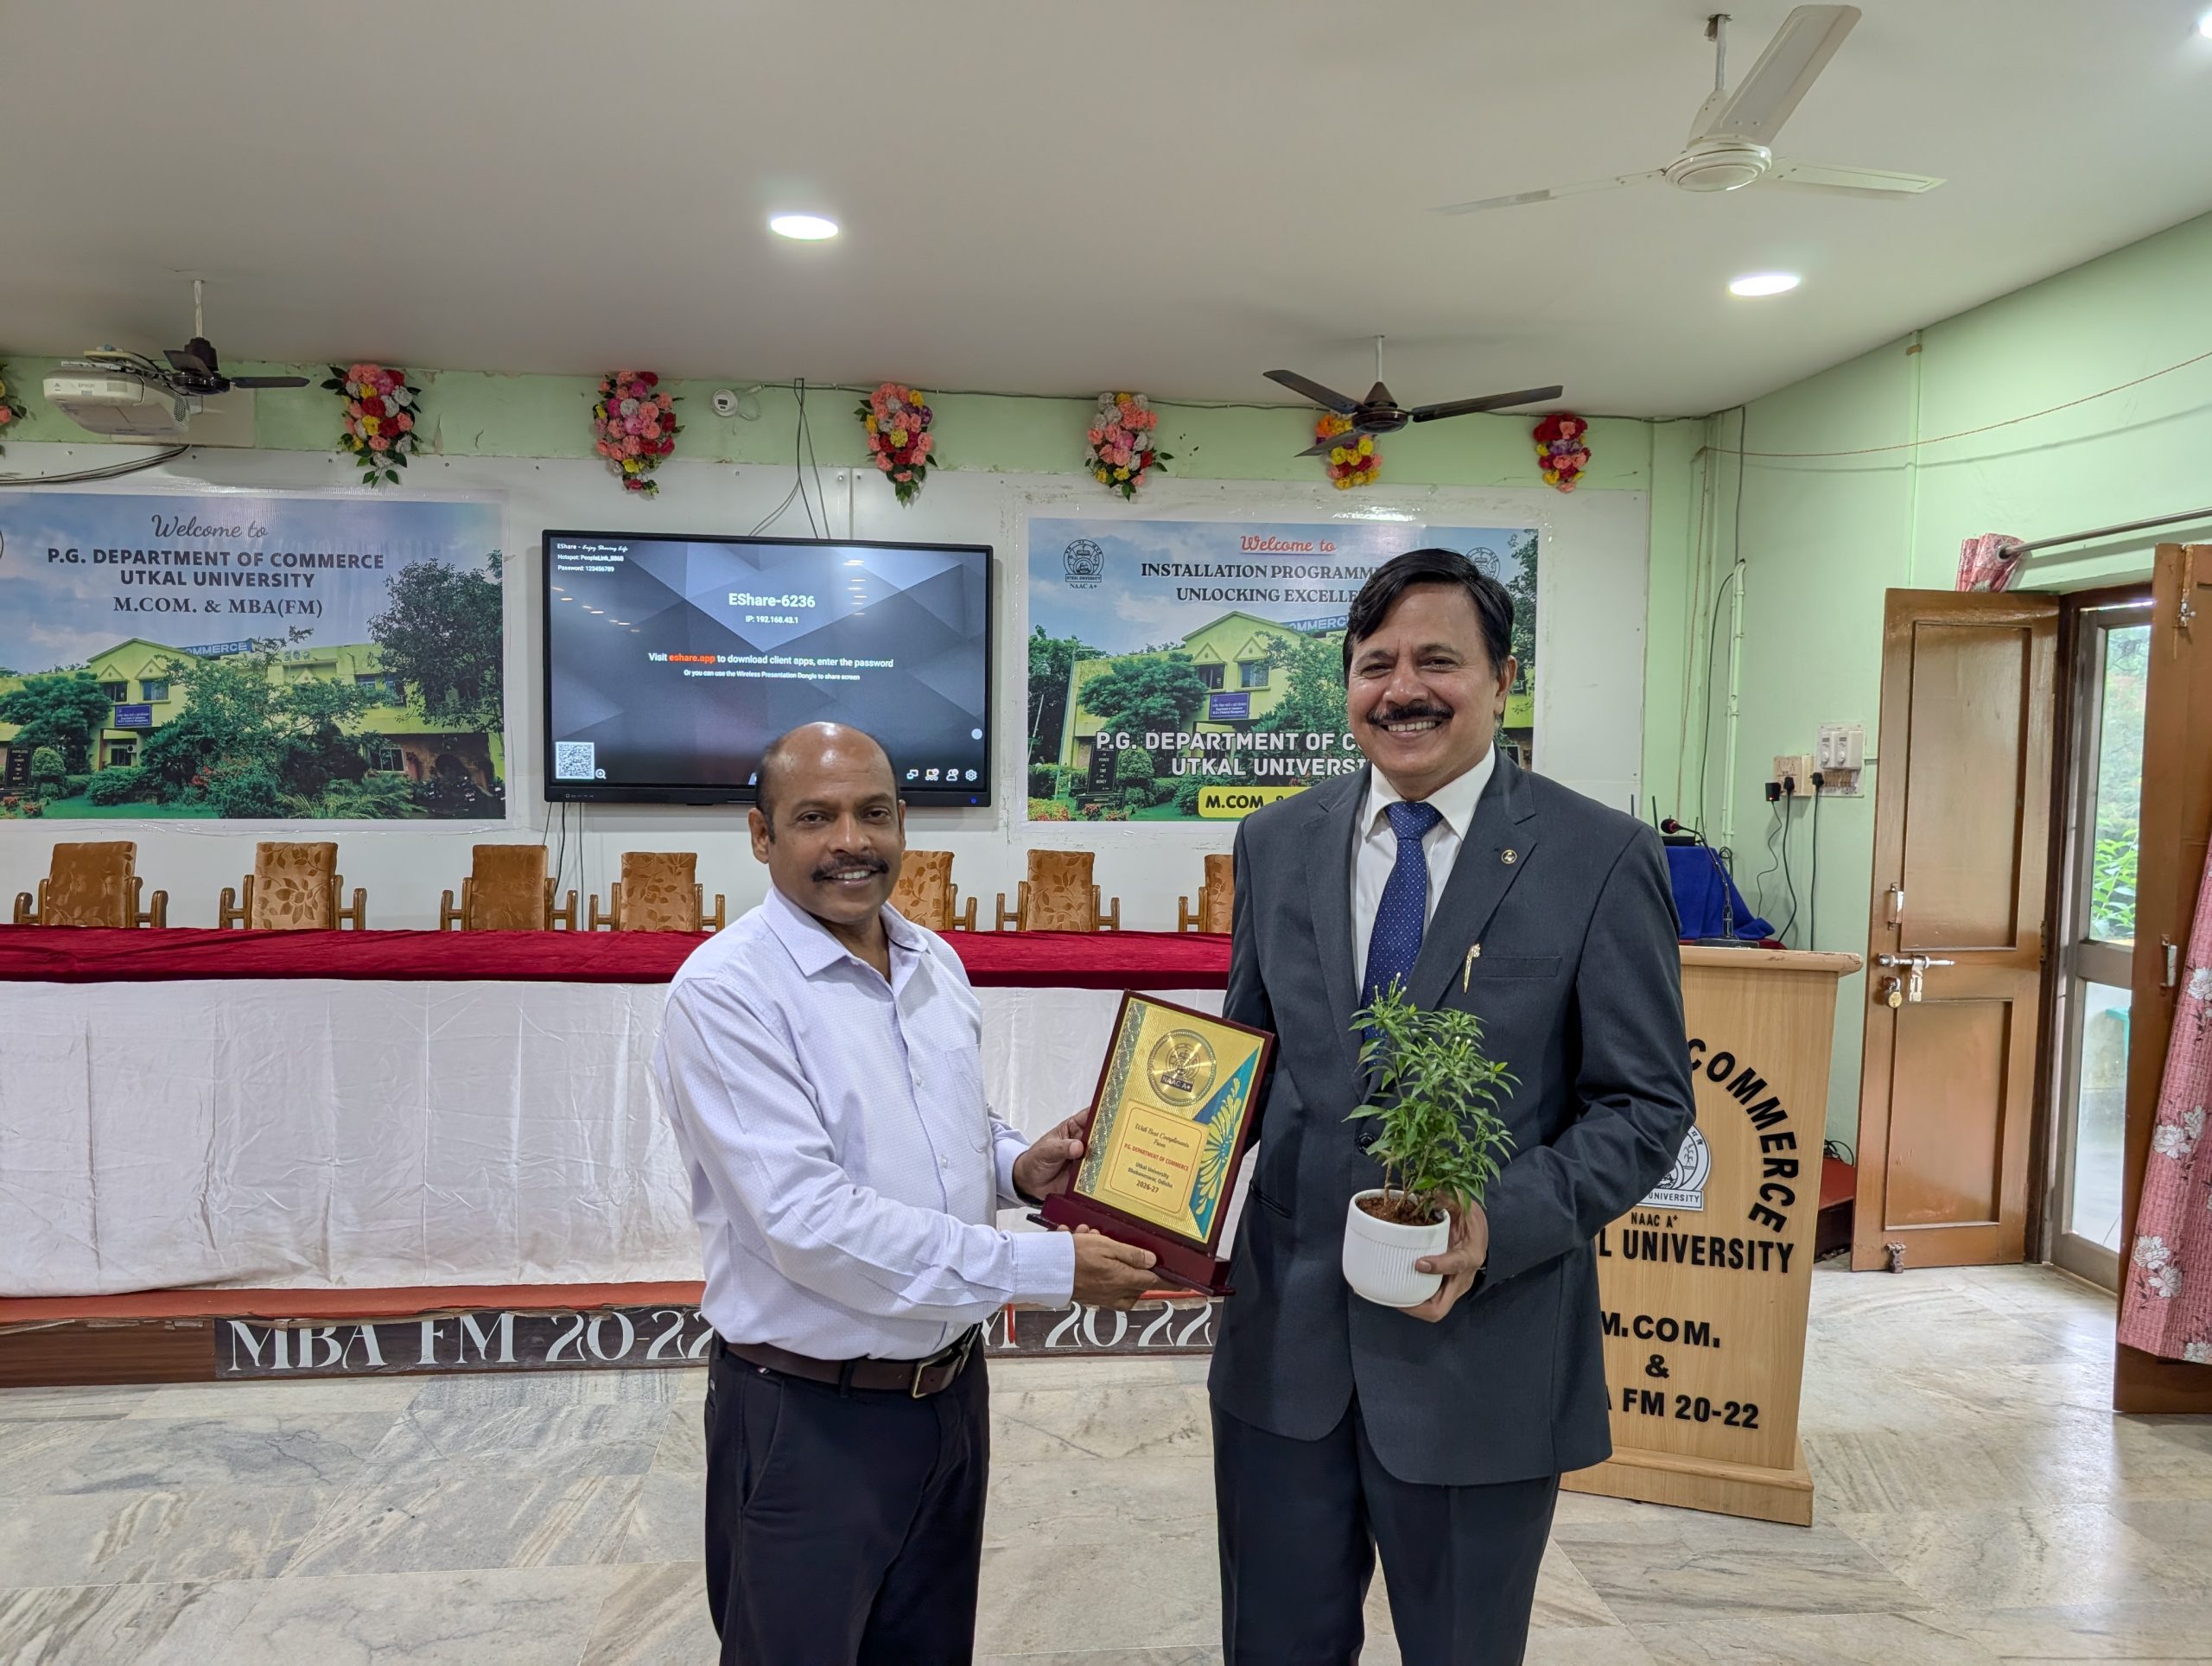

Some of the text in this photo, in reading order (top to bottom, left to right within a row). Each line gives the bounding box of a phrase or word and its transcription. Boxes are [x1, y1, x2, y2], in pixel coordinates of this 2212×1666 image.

[151, 514, 268, 538] Welcome to
[1240, 536, 1337, 552] Welcome to
[48, 548, 385, 569] P.G. DEPARTMENT OF COMMERCE
[120, 570, 315, 588] UTKAL UNIVERSITY
[1141, 563, 1379, 580] INSTALLATION PROGRAMM
[728, 593, 816, 608] EShare-6236
[1176, 588, 1361, 603] UNLOCKING EXCELLE
[113, 596, 323, 619] M.COM. & MBA(FM)
[756, 615, 798, 624] 192.168.43.1
[186, 642, 248, 656] OMMERCE
[648, 652, 894, 669] Visit eshare.app to download client apps, enter the password
[1096, 731, 1137, 750] P.G.
[1146, 732, 1299, 751] DEPARTMENT
[1306, 733, 1335, 751] OF
[1172, 758, 1369, 777] UTKAL UNIVERSI
[1162, 1075, 1181, 1087] NAAC
[1688, 1039, 1799, 1233] COMMERCE
[1132, 1146, 1159, 1160] DEPARTMENT
[1166, 1158, 1190, 1173] COMMERCE
[1136, 1180, 1160, 1193] 2026-27
[1648, 1192, 1700, 1203] UNIVERSITY
[1630, 1211, 1661, 1227] NAAC
[1623, 1229, 1795, 1274] UNIVERSITY
[1045, 1300, 1213, 1347] 20-22
[1600, 1310, 1720, 1348] M.COM.
[228, 1319, 386, 1372] MBA
[416, 1313, 519, 1365] FM
[1645, 1354, 1669, 1379] &
[1622, 1388, 1665, 1417] FM
[1675, 1395, 1759, 1429] 20-22
